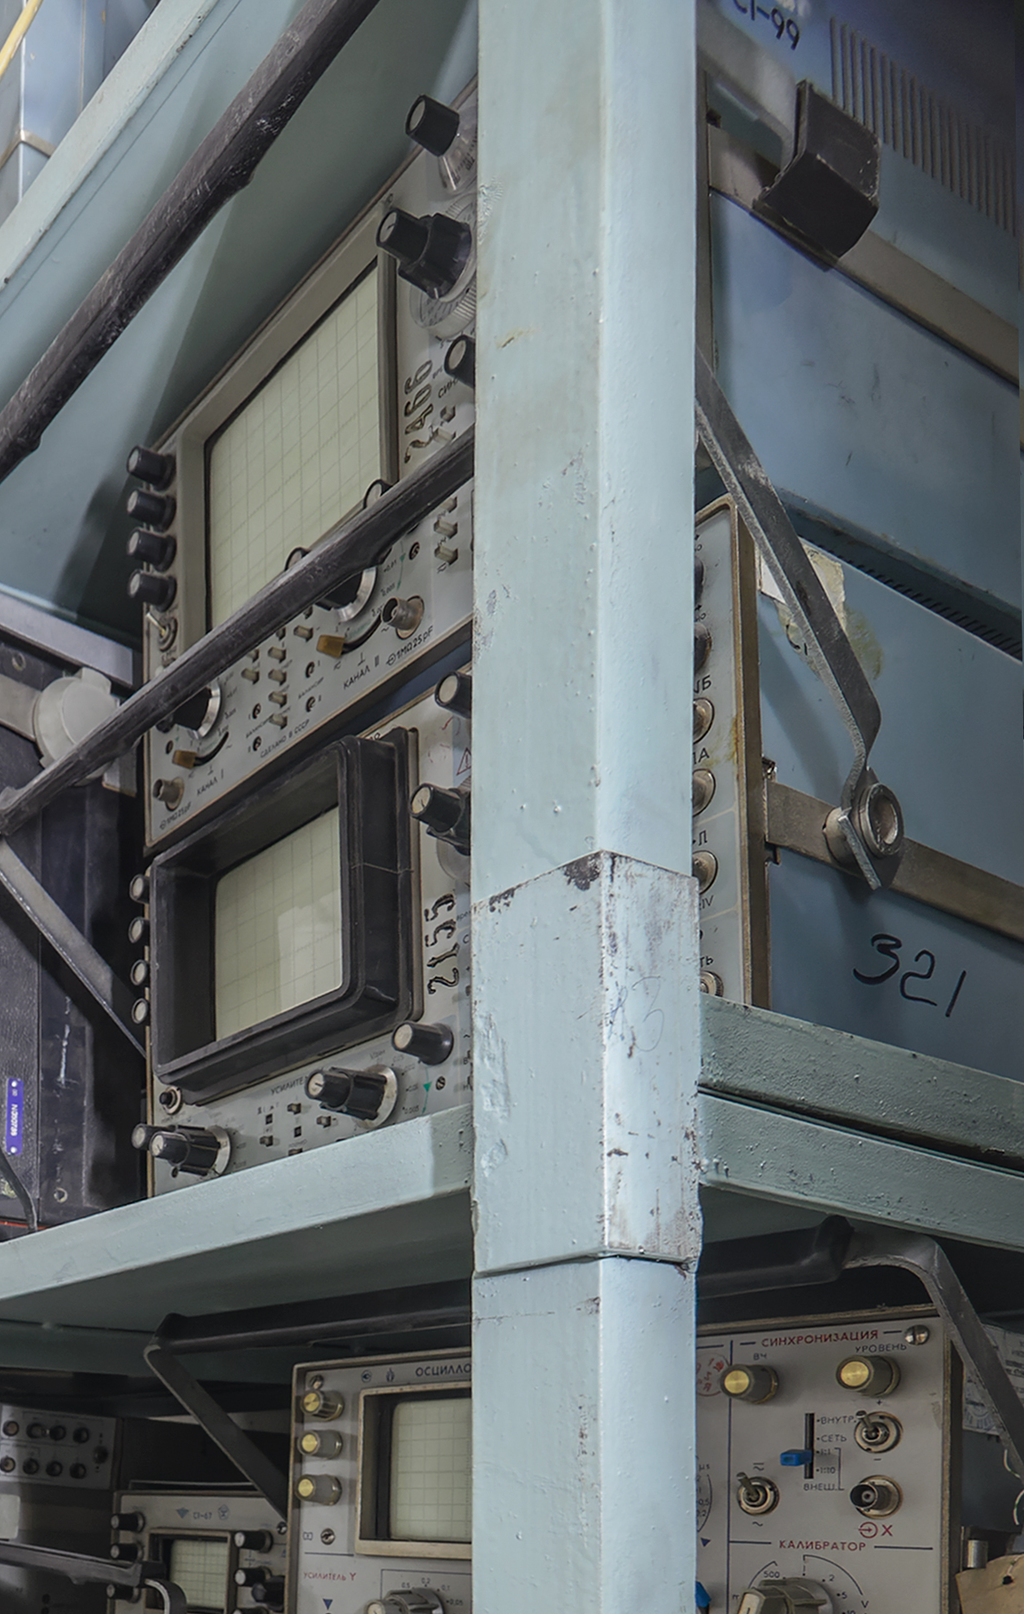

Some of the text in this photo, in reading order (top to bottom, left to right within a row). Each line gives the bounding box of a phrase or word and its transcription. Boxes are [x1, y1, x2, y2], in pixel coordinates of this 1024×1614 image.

[343, 665, 370, 690] КАНАЛ
[260, 736, 287, 759] СДЕЛАНО
[293, 719, 310, 736] СССР
[424, 893, 460, 994] 2155
[853, 933, 967, 1018] 321
[761, 1329, 880, 1348] СИНХРОНИЗАЦИЯ
[855, 1343, 907, 1354] УРОВЕНЬ
[753, 1352, 768, 1361] ВЧ
[820, 1434, 848, 1443] СЕТЬ
[779, 1540, 867, 1552] КАЛИБРАТОР
[303, 1572, 346, 1581] УСИЛИТЕЛЬ
[763, 1570, 781, 1579] 500
[828, 1574, 835, 1582] 2
[841, 1591, 848, 1600] 5
